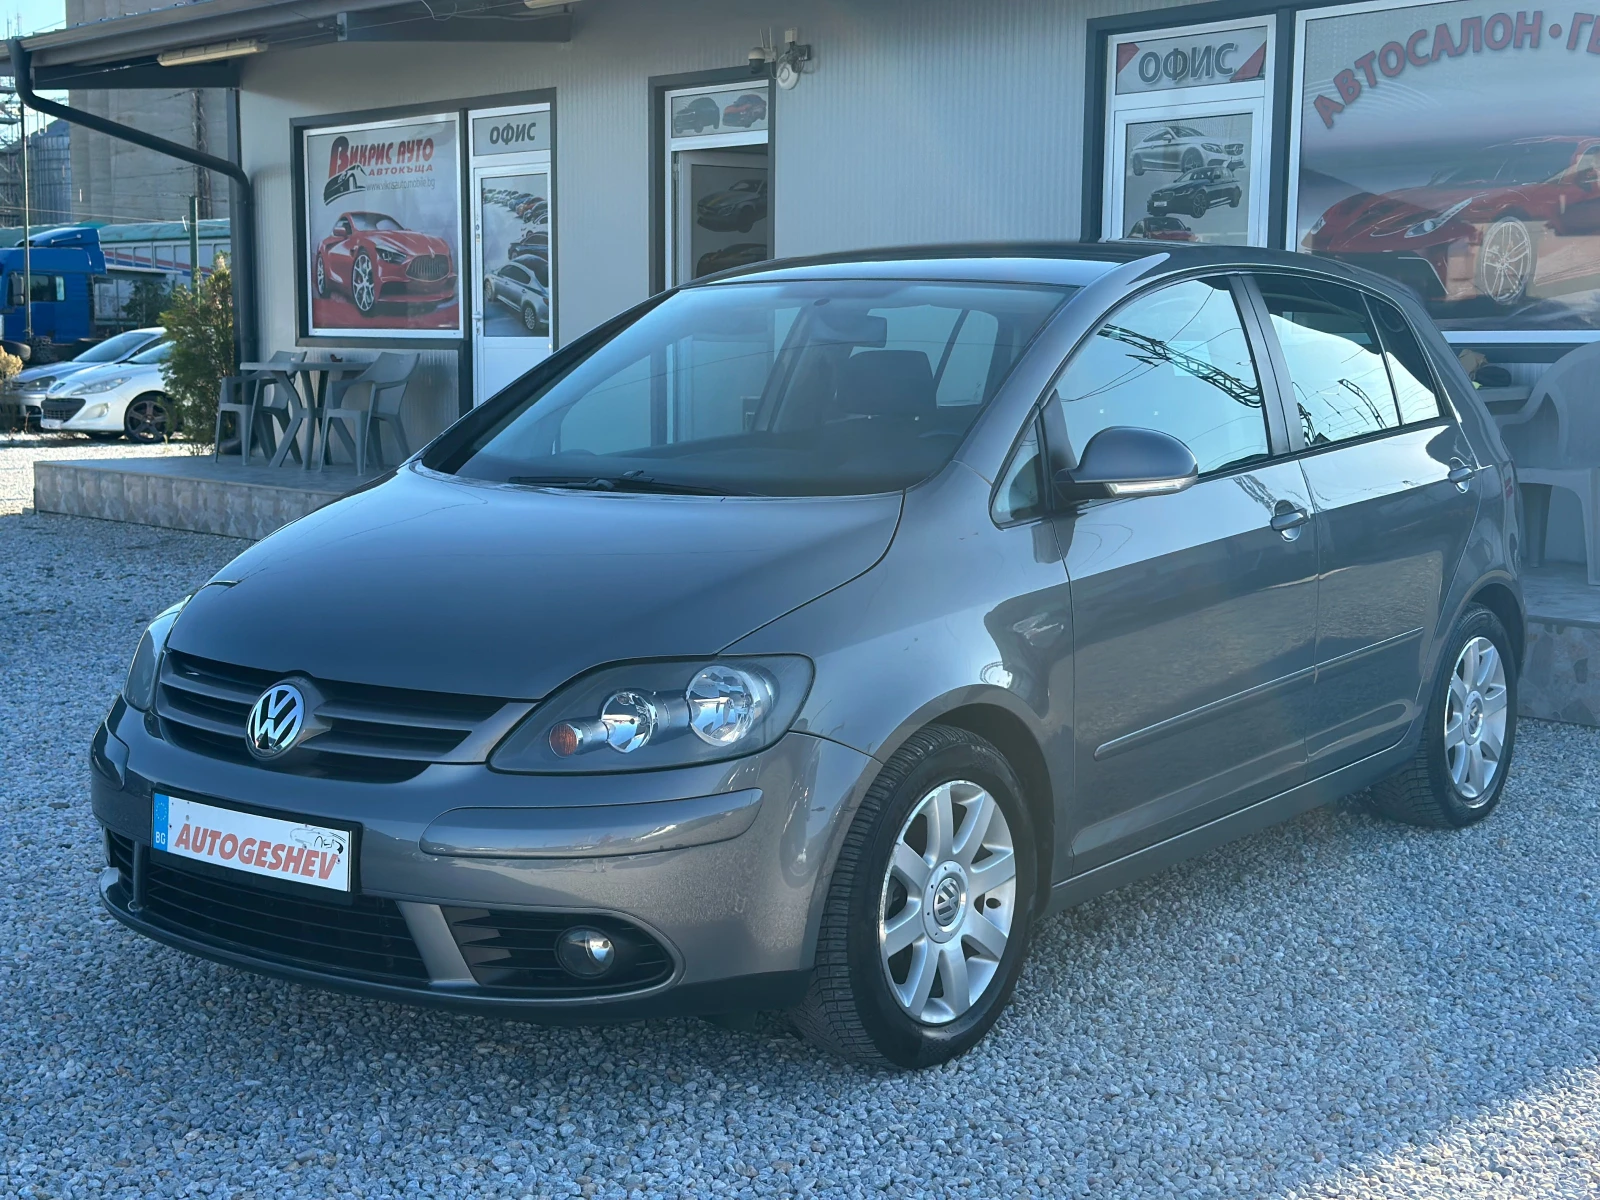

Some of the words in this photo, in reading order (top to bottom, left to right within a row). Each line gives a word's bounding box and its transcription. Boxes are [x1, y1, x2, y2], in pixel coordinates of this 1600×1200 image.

[1138, 43, 1236, 83] ОФИС
[1313, 11, 1543, 129] АВТОСАЛОН
[489, 122, 537, 145] ОФИС
[368, 164, 433, 176] АВТОКЪЩА
[155, 831, 166, 845] BG
[174, 823, 339, 880] AUTOGESHEV
